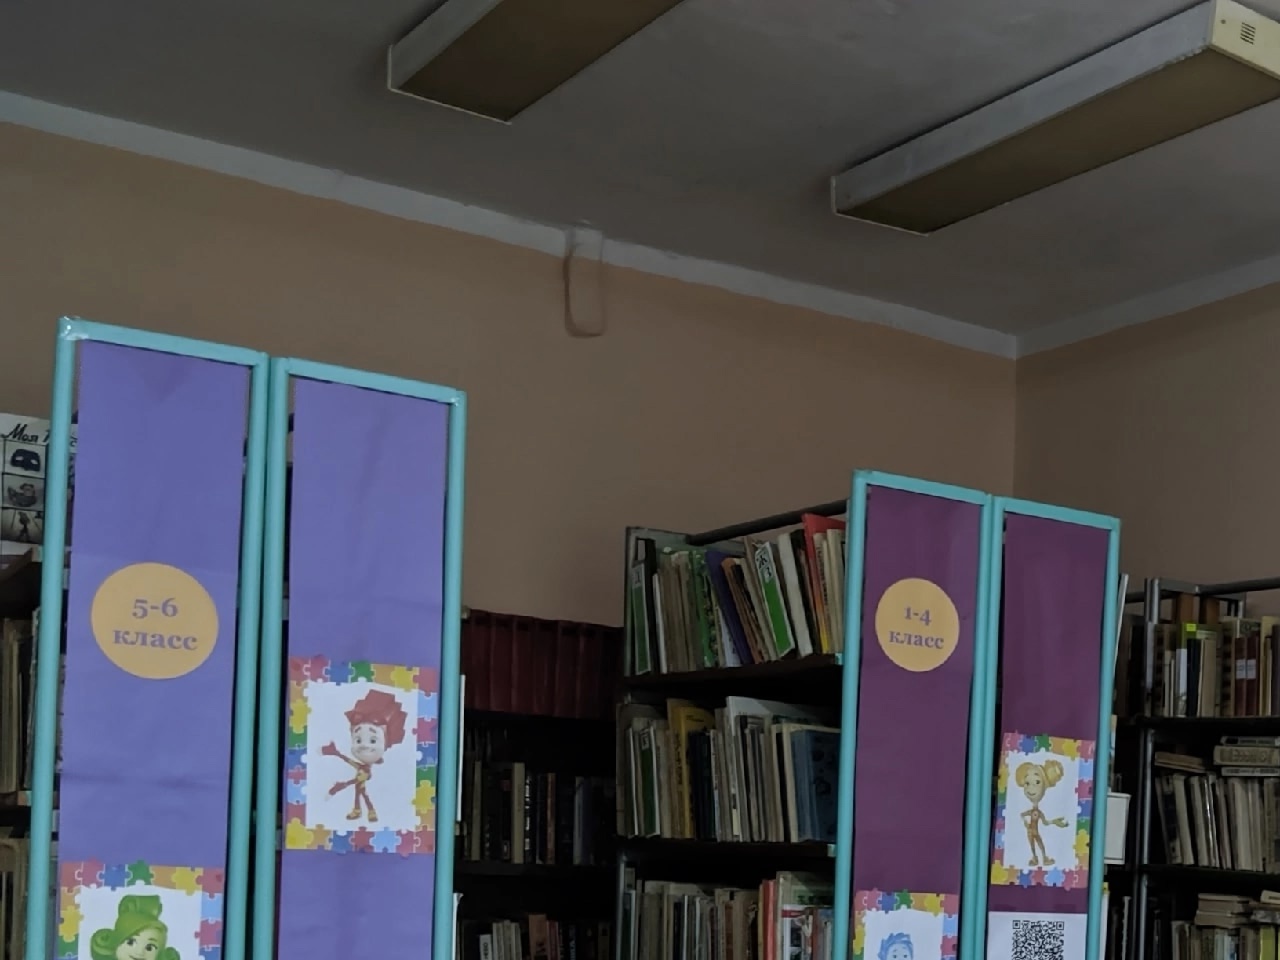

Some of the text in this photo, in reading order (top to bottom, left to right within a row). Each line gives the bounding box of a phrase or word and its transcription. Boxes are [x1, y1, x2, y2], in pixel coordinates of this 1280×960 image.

[131, 595, 179, 619] 5-6
[904, 606, 932, 626] 1-4
[112, 626, 198, 651] класс
[888, 629, 945, 650] класс
